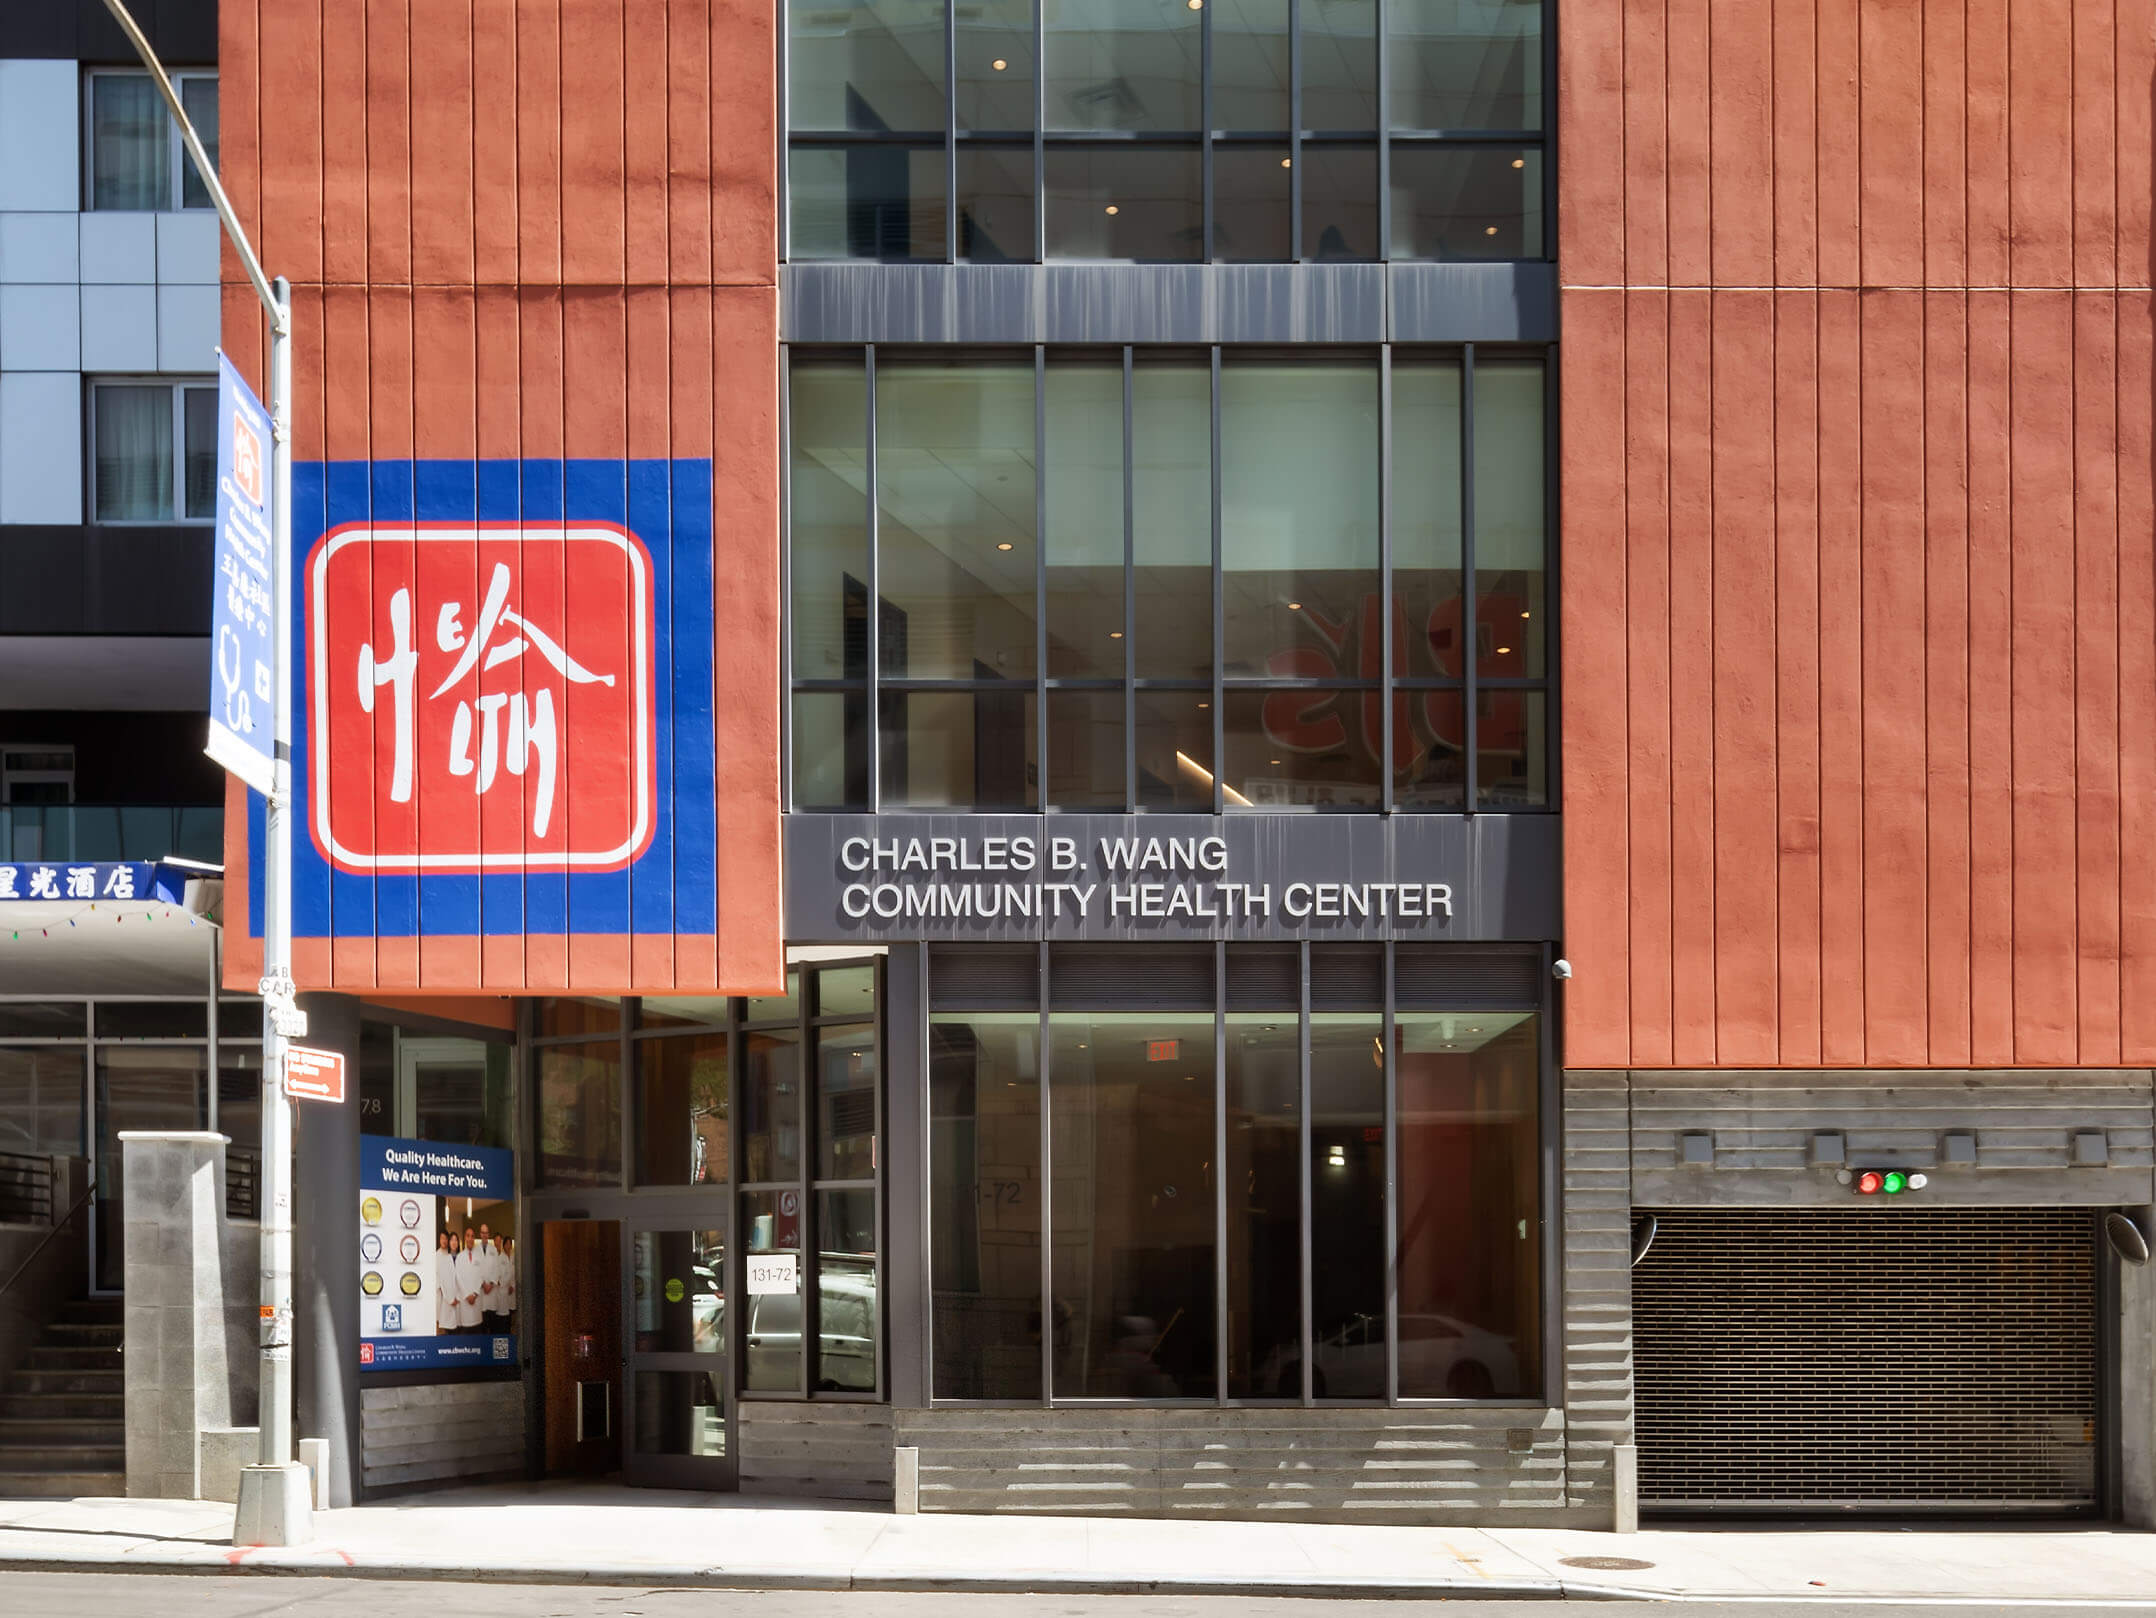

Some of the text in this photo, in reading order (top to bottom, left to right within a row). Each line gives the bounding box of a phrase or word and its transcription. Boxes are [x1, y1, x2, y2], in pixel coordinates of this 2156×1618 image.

[841, 837, 1228, 871] CHARLES B. WANG
[841, 883, 1453, 918] COMMUNITY HEALTH CENTER
[385, 1148, 484, 1170] Quality Healthcare.
[382, 1168, 488, 1188] We Are Here For You.
[752, 1267, 792, 1281] 131-72
